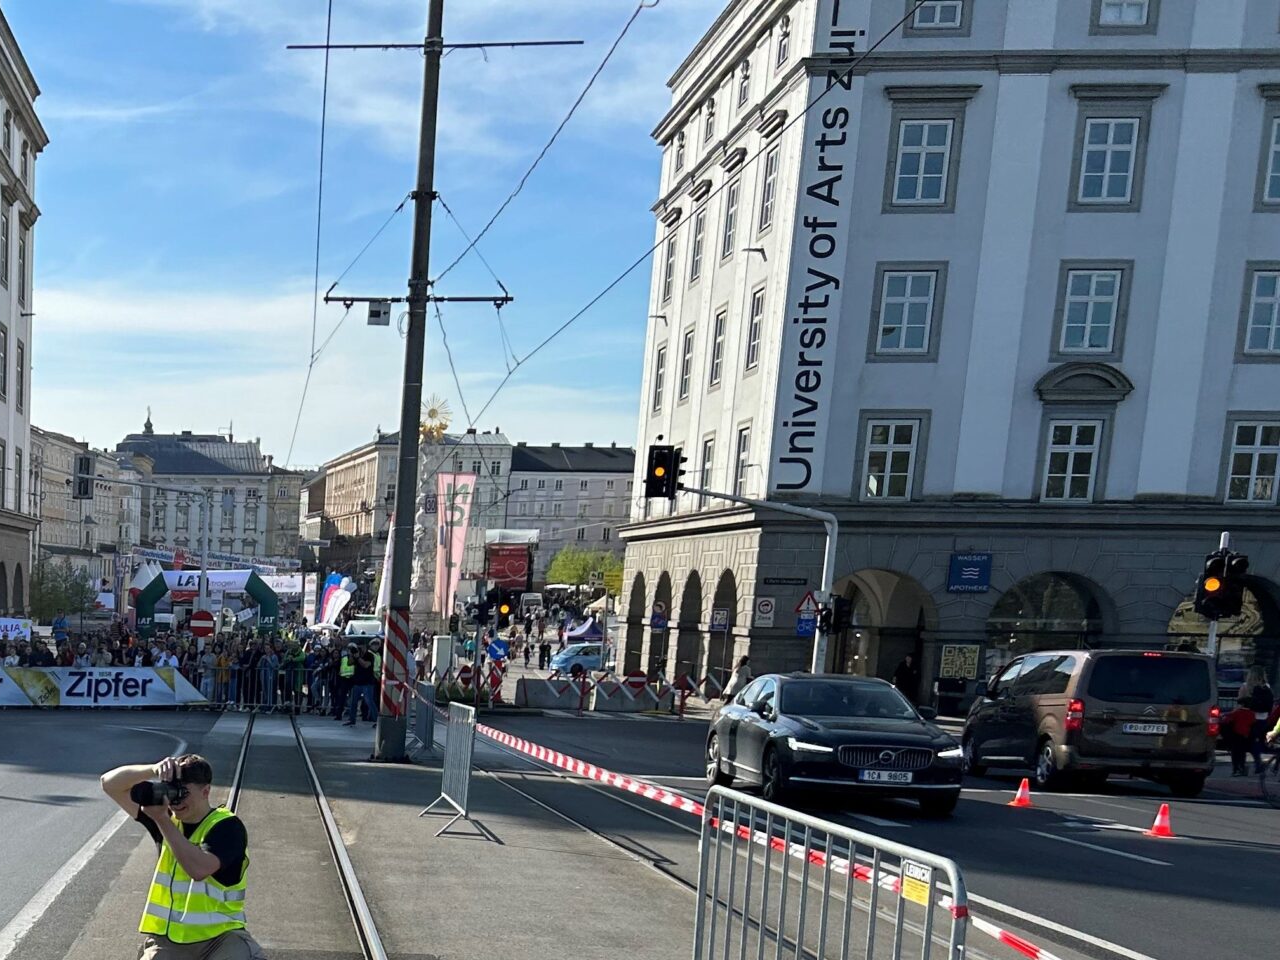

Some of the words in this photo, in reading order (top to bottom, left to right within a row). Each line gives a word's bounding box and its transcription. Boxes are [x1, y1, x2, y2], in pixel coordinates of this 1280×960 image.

[806, 106, 850, 207] Arts
[803, 215, 837, 259] of
[776, 267, 840, 490] University
[137, 617, 153, 625] LAT
[260, 616, 276, 624] LAT
[65, 671, 153, 703] Zipfer
